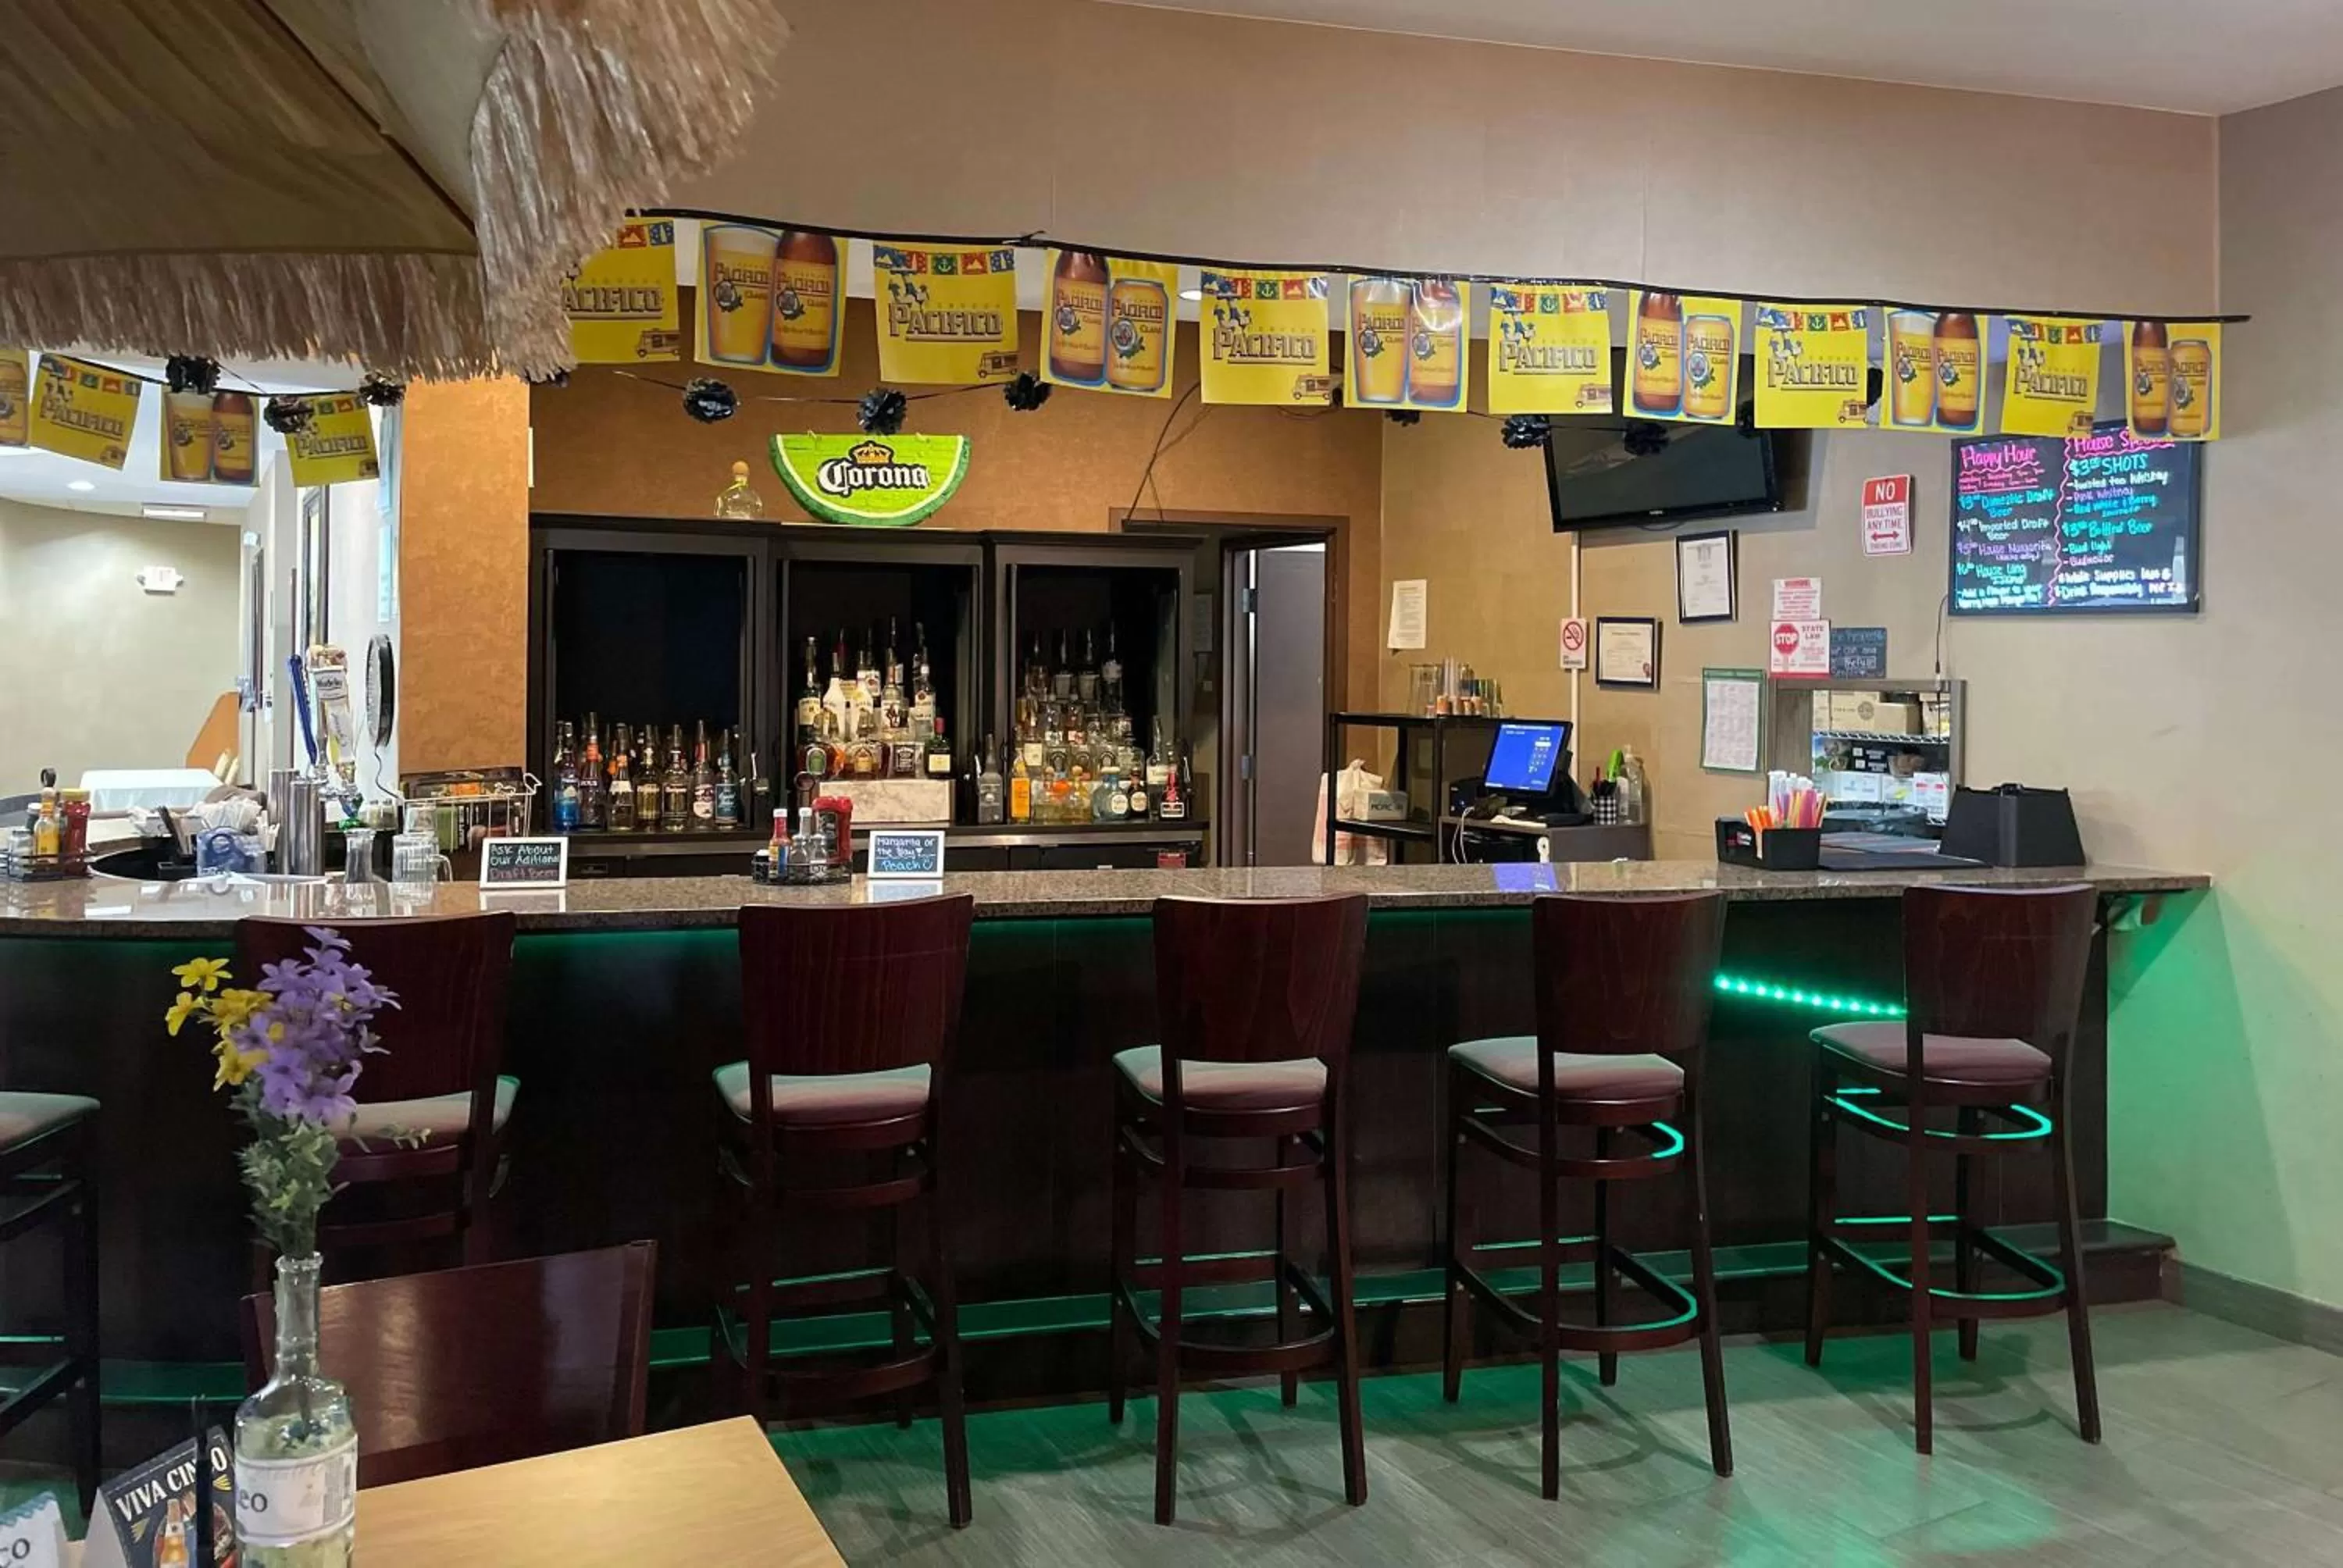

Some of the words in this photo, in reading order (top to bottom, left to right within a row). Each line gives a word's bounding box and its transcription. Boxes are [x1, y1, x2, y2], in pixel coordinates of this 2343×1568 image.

[562, 287, 662, 312] ACIFICO
[889, 303, 1002, 337] PACIFICO
[1213, 328, 1317, 360] PACIFICO
[1499, 340, 1597, 372] PACIFICO
[1767, 358, 1858, 387] PACIFICO
[2013, 366, 2088, 397] PACIFICO
[1960, 445, 2002, 469] Happy
[2004, 444, 2036, 462] Hour
[2102, 453, 2149, 475] SHOTS
[818, 461, 930, 494] Corona
[1875, 481, 1895, 501] NO
[490, 844, 513, 855] Ask
[518, 844, 555, 855] About
[490, 856, 512, 866] Our
[881, 860, 920, 871] Peach
[116, 1480, 167, 1522] VIVA
[166, 1447, 227, 1492] CINO
